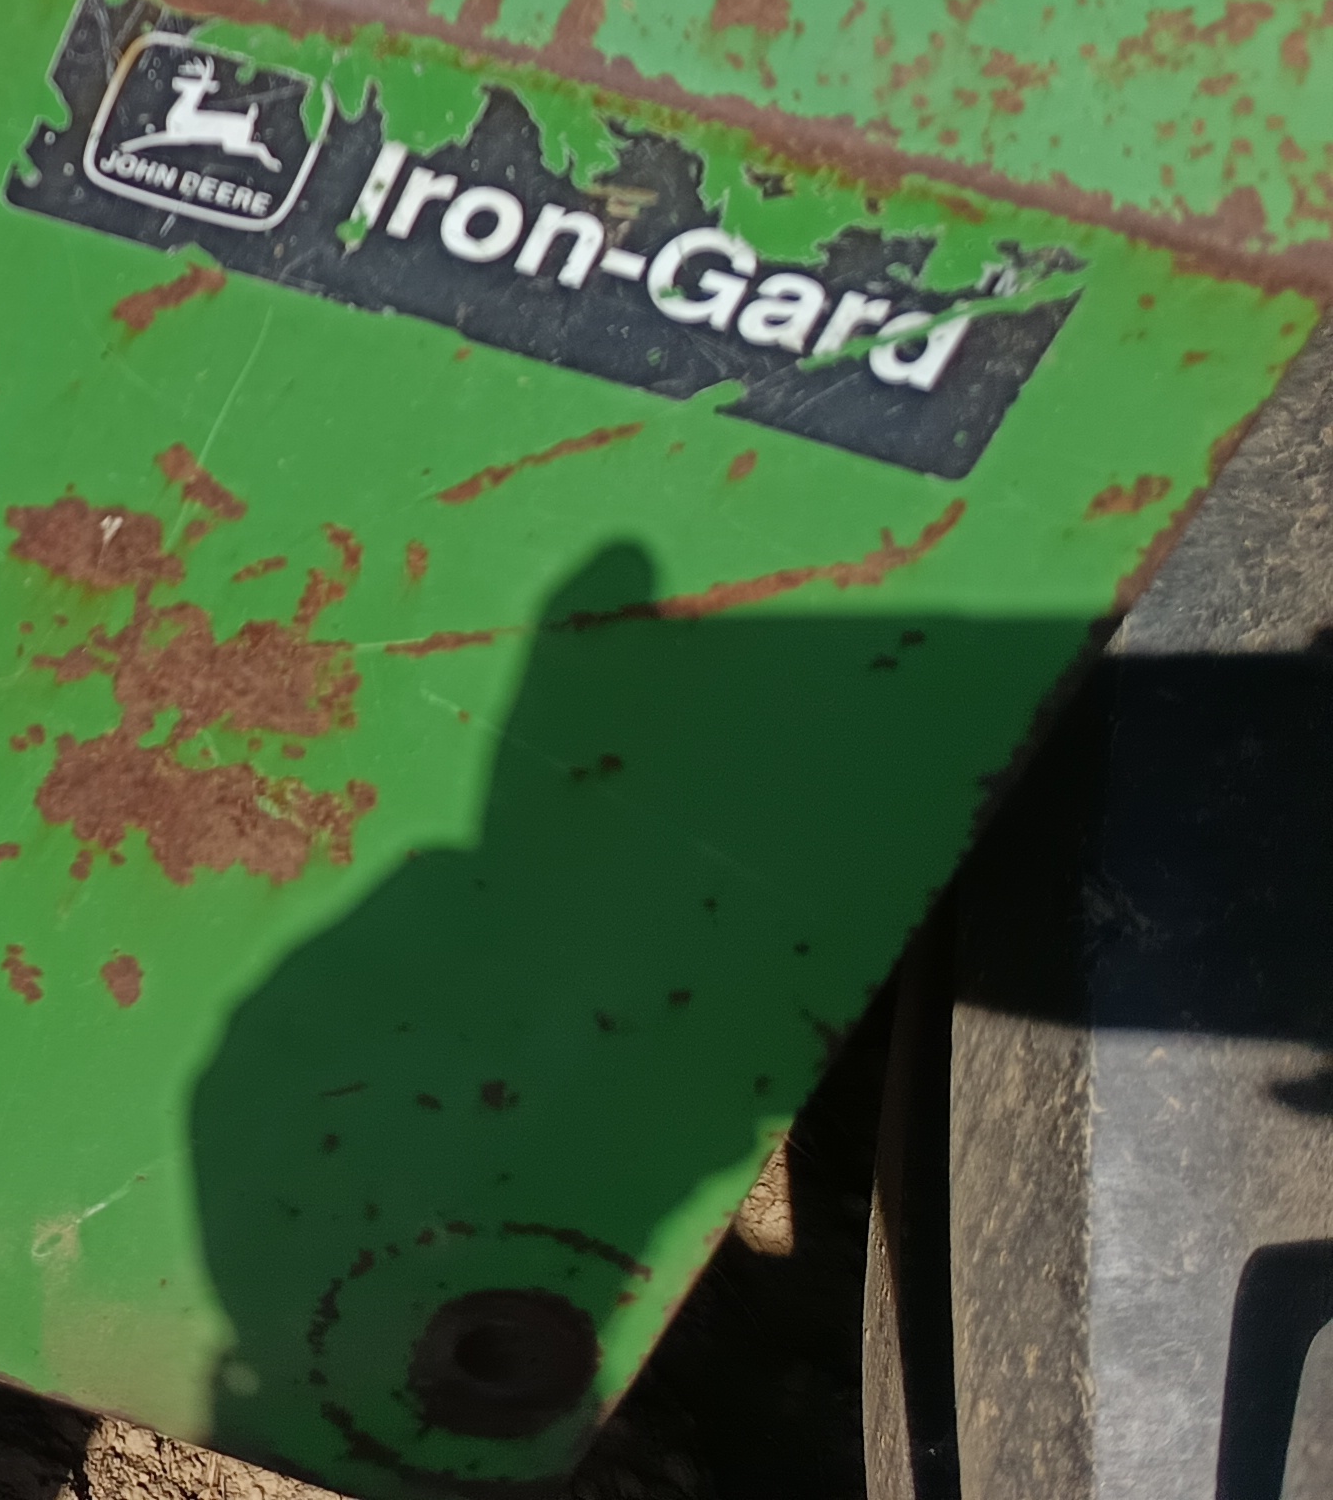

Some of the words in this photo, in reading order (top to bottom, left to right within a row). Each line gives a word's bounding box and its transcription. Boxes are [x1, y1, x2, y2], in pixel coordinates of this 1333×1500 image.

[99, 150, 178, 190] JOHN
[178, 170, 273, 216] DEERE
[347, 141, 972, 393] Iron-Gard
